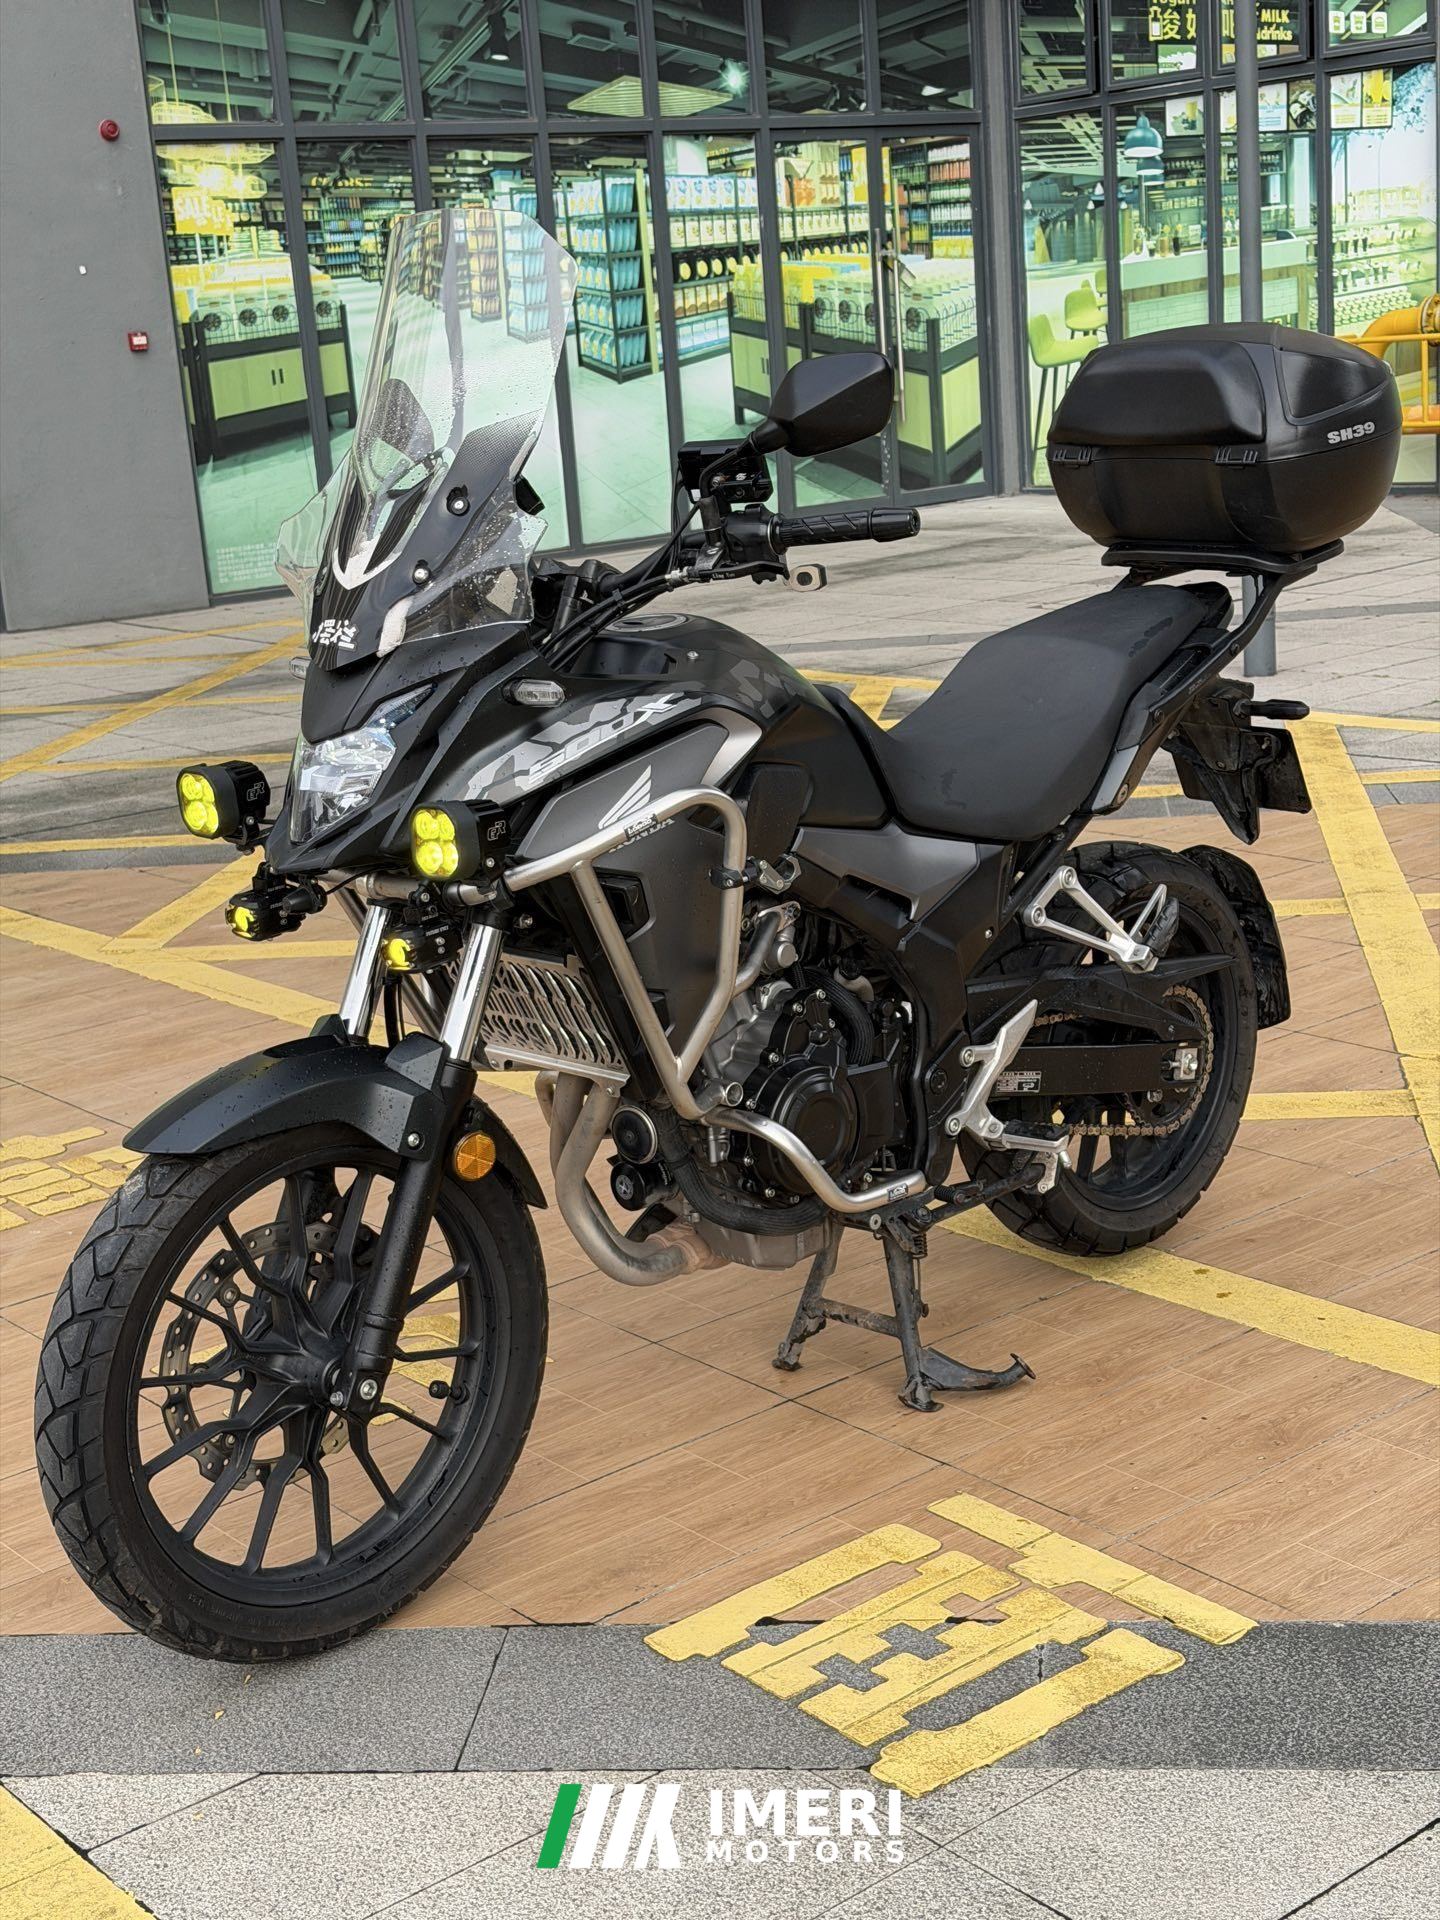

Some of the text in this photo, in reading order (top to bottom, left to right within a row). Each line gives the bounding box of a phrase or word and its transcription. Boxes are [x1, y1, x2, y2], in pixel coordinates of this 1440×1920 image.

[1260, 8, 1291, 24] MILK
[1260, 24, 1294, 42] drinks
[1326, 421, 1376, 445] SH39
